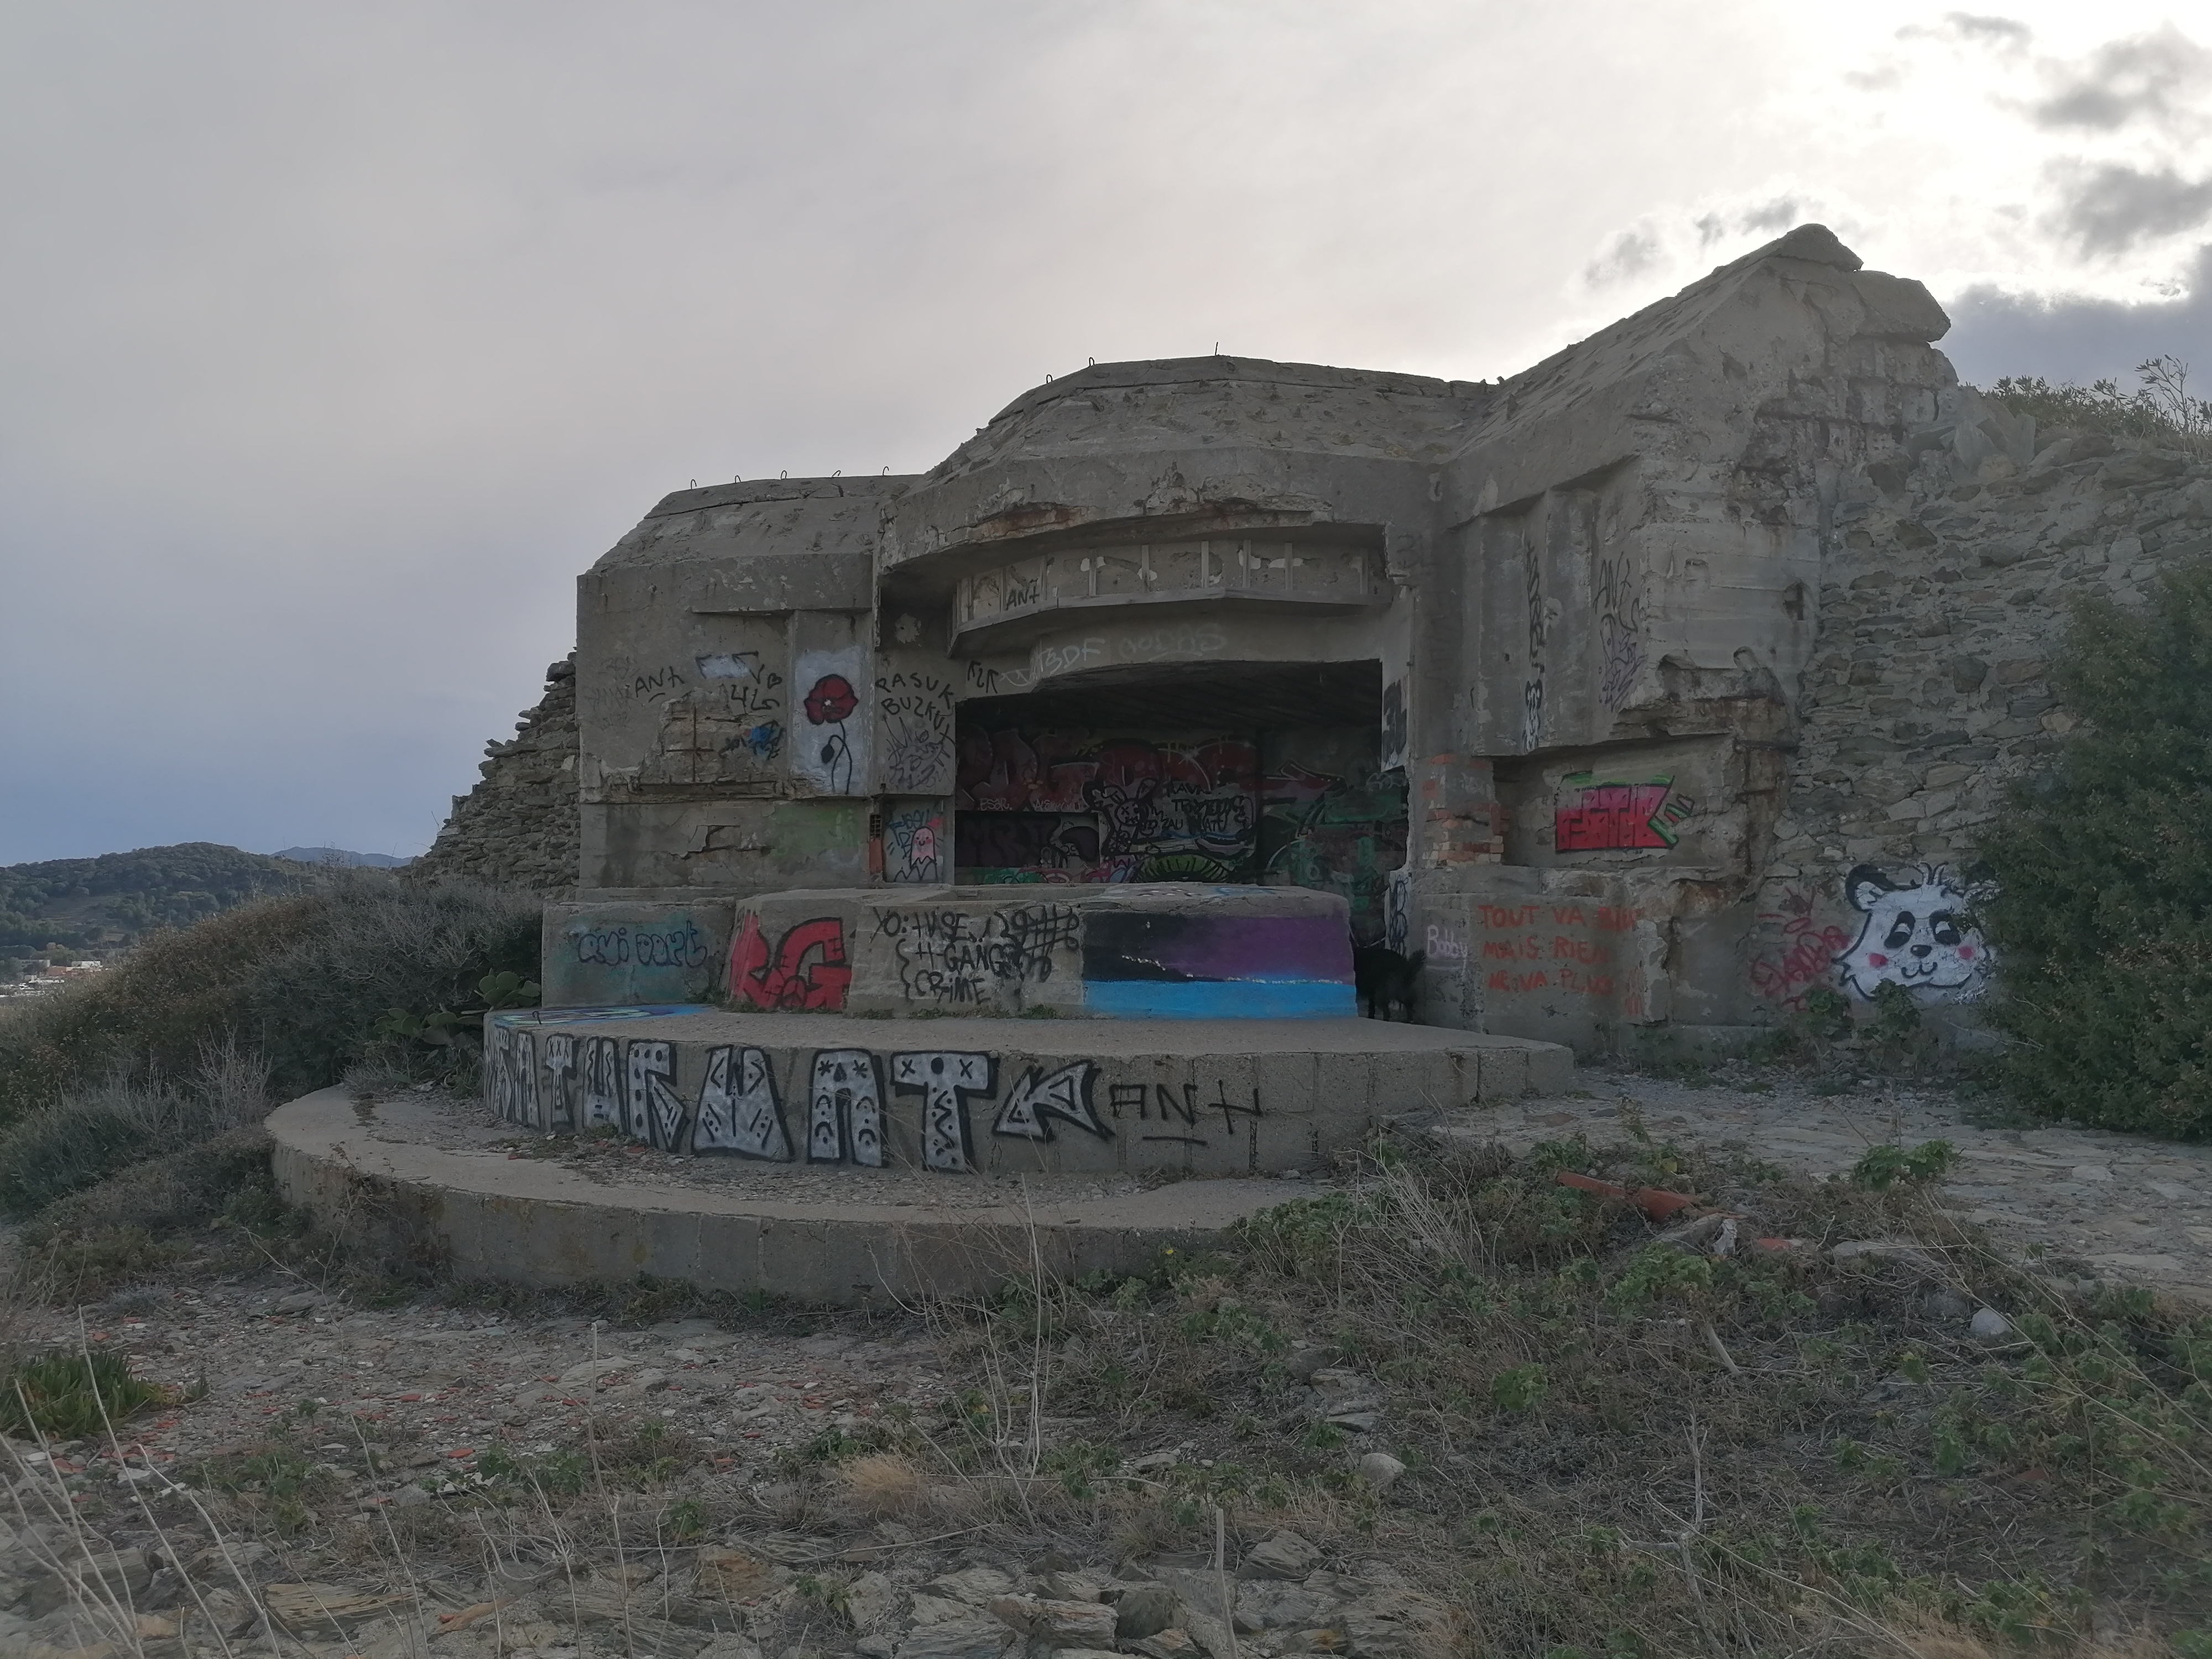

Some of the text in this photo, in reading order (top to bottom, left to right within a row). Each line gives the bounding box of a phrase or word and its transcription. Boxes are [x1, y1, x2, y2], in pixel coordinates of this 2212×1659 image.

[1478, 904, 1540, 930] TOUT
[1550, 905, 1588, 928] VA
[1483, 935, 1609, 965] MAIS RIEN
[1519, 970, 1548, 992] VA
